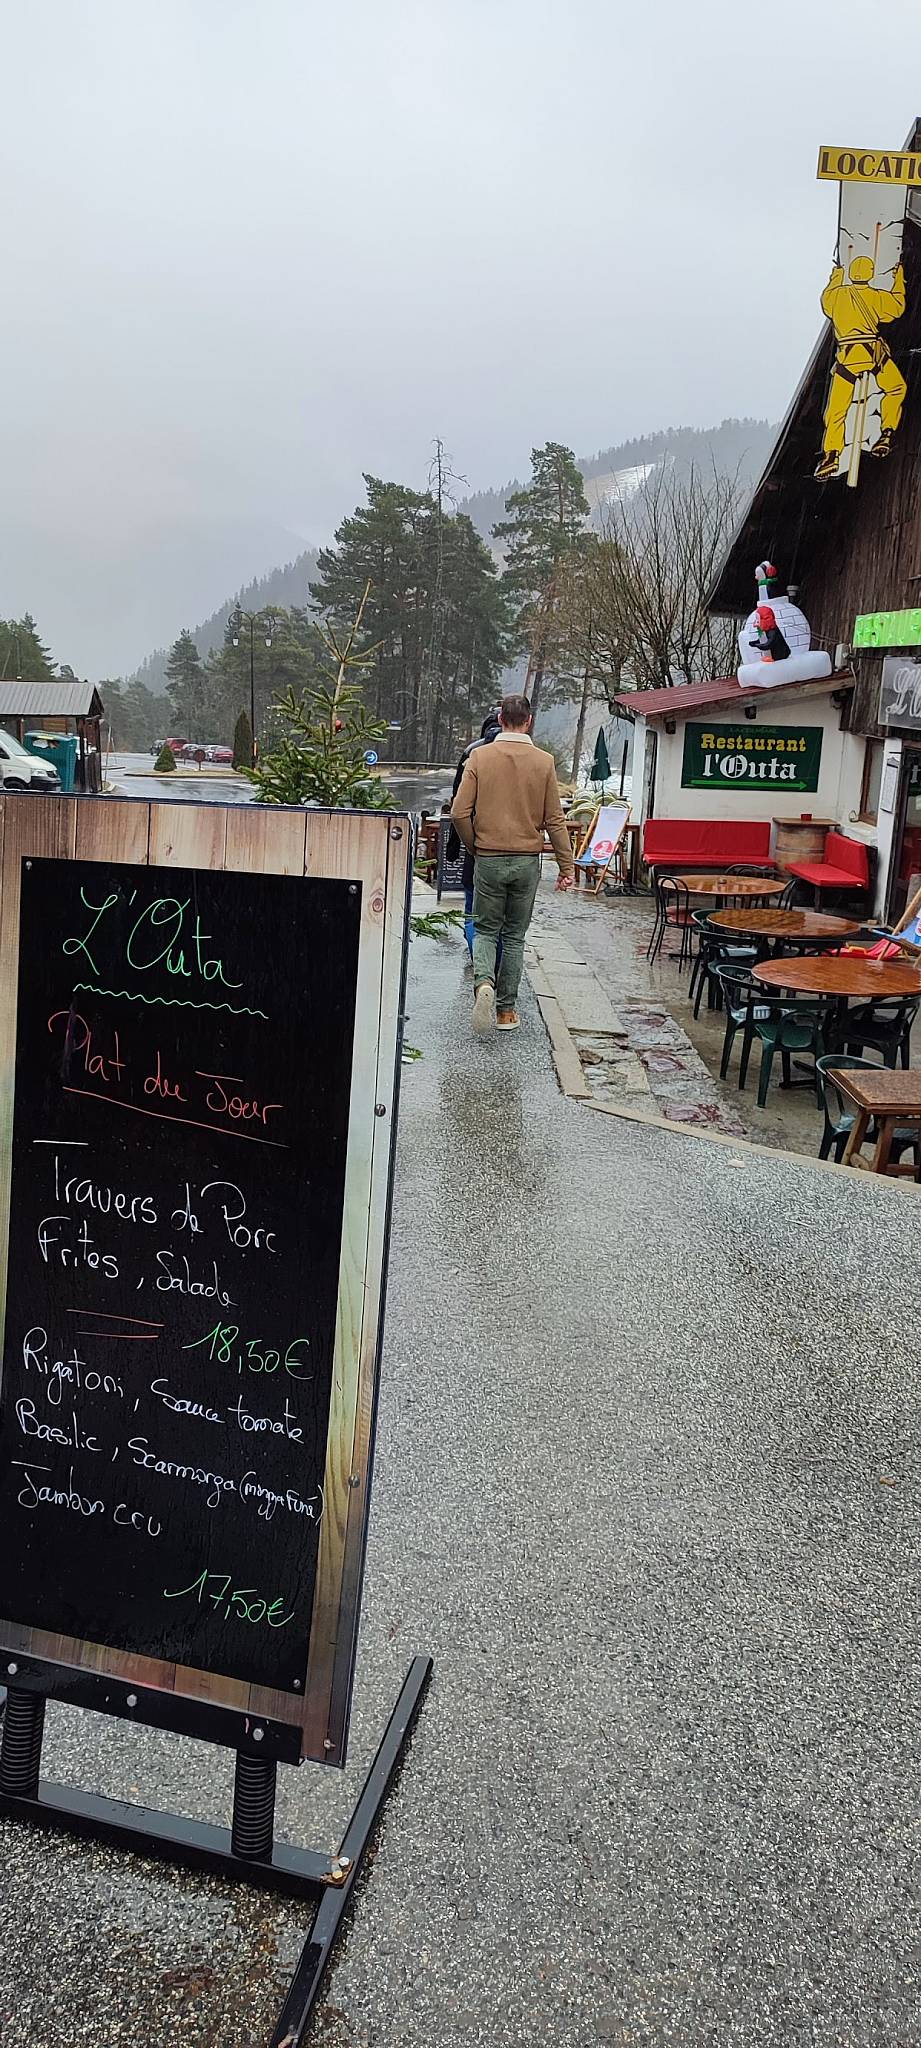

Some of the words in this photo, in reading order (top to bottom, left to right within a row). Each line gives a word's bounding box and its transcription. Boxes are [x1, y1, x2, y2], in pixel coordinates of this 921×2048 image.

[821, 152, 921, 180] LOCATI
[700, 732, 807, 752] Restaurant
[702, 753, 797, 780] l'Outa
[62, 886, 244, 988] L'Outa
[48, 1010, 126, 1082] Plat
[144, 1051, 188, 1103] du
[195, 1070, 284, 1124] Jour
[33, 1139, 158, 1224] Travers
[170, 1182, 204, 1233] de
[200, 1180, 278, 1253] Porc
[155, 1249, 240, 1307] Salade
[181, 1321, 314, 1381] 18,50€
[150, 1377, 228, 1425] Sauce
[227, 1394, 305, 1445] tomate
[11, 1459, 105, 1517] Jambon
[163, 1568, 296, 1628] 17,50€
